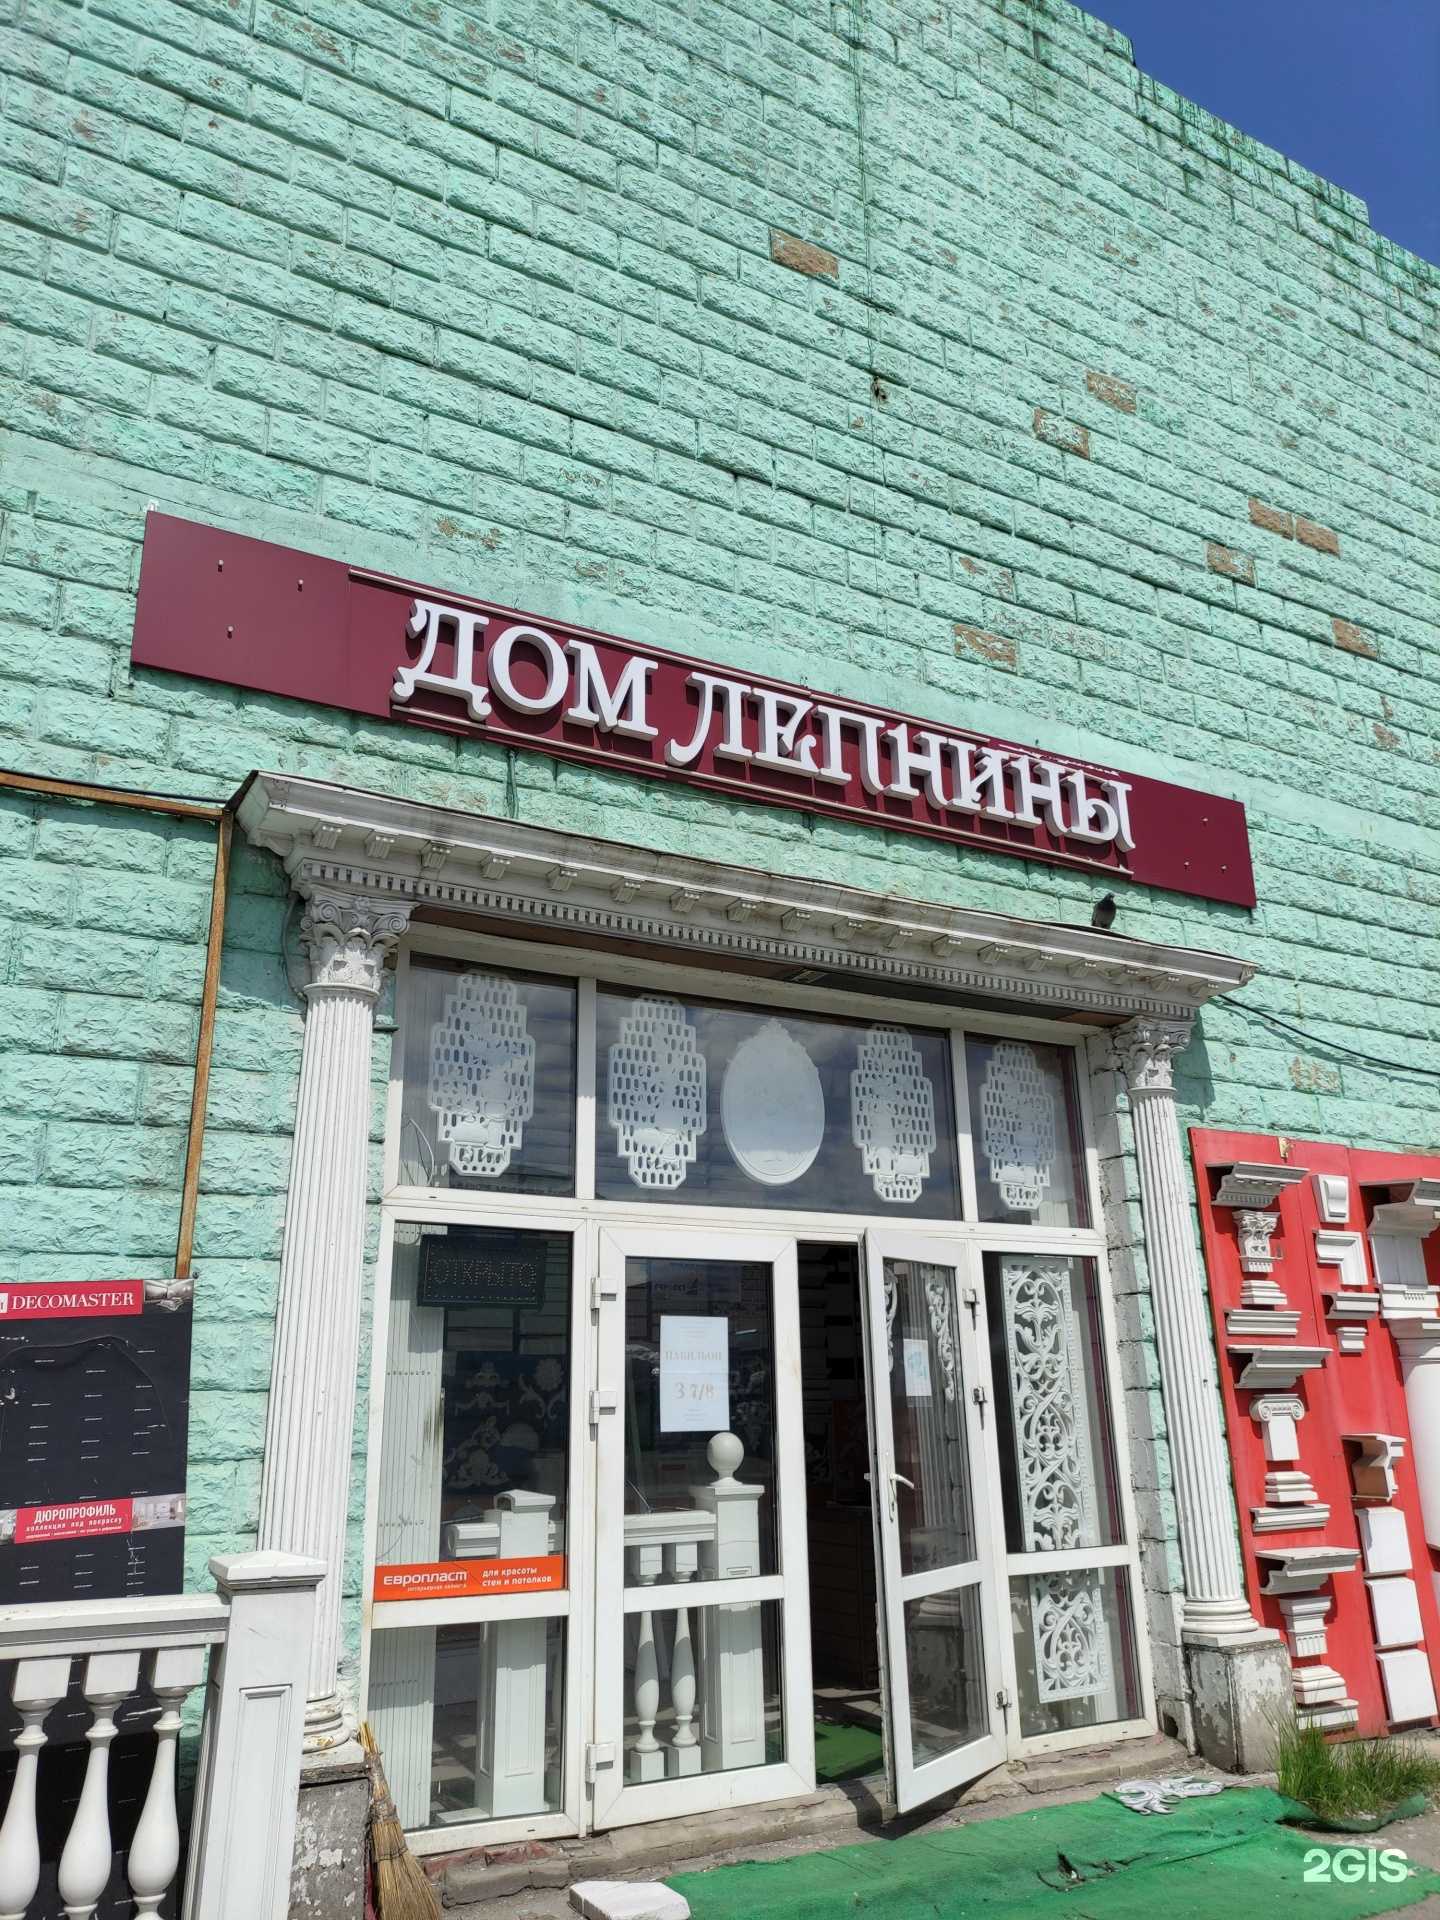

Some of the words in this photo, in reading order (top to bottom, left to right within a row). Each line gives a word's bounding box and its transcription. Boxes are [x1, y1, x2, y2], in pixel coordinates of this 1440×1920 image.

[390, 598, 660, 742] ДОМ
[663, 671, 1136, 853] ЛЕПНИНЫ
[12, 1292, 134, 1310] DECOMASTER
[34, 1503, 116, 1525] ДЮРОПРОФИЛЬ
[482, 1569, 499, 1578] для
[501, 1567, 537, 1576] красоты
[482, 1579, 501, 1587] стен
[511, 1575, 552, 1584] потолков
